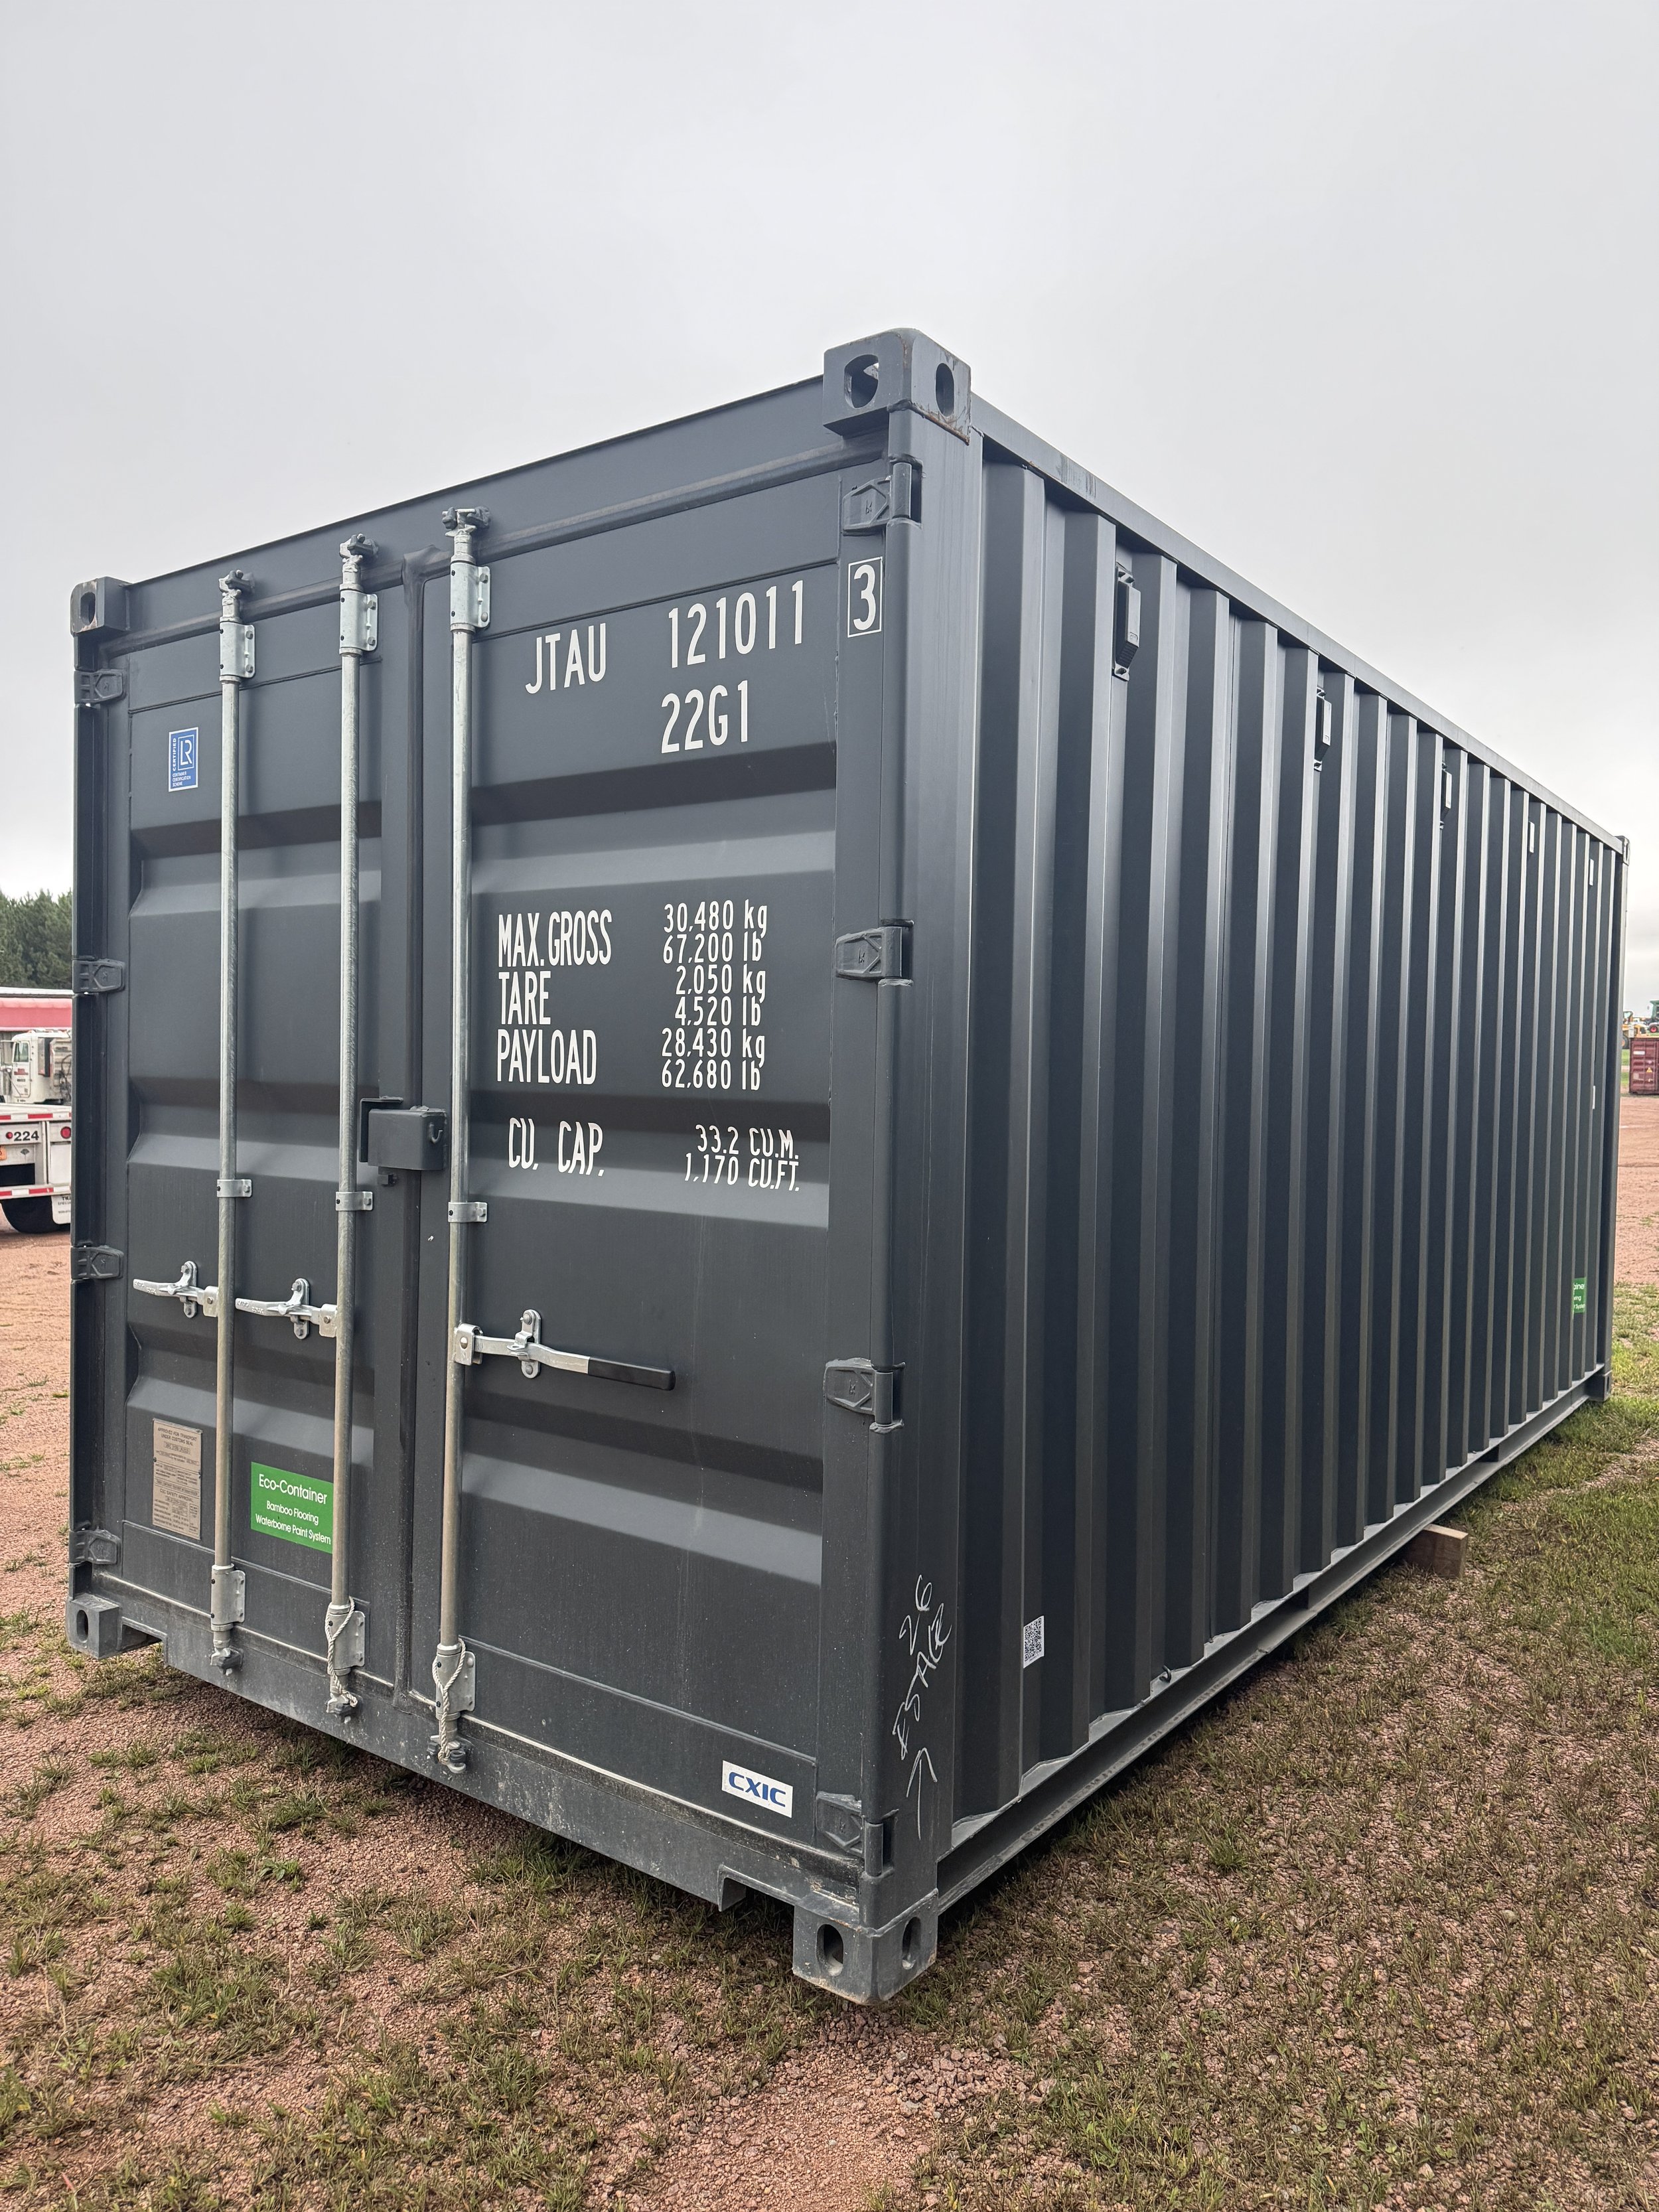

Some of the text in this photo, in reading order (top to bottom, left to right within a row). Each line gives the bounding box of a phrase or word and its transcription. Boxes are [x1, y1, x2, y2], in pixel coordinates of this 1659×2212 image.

[525, 564, 876, 694] JTAU 121011 3
[662, 680, 748, 753] 22G1
[180, 739, 192, 765] LR
[744, 899, 767, 938] kg
[744, 931, 762, 961] lb
[498, 971, 551, 1025] TARE
[743, 964, 766, 1003] kg
[743, 996, 761, 1025] lb
[497, 1029, 597, 1084] PAYLOAD
[742, 1028, 764, 1068] kg
[742, 1060, 760, 1090] lb
[13, 1131, 39, 1141] 224
[508, 1118, 538, 1170] CU.
[558, 1121, 605, 1176] CAP.
[695, 1125, 739, 1154] 33.2
[259, 1473, 327, 1505] Eco-Container
[255, 1513, 331, 1545] Waterborne Paint System
[267, 1500, 319, 1526] Bamboo Flooring
[729, 1772, 786, 1807] CXIC
